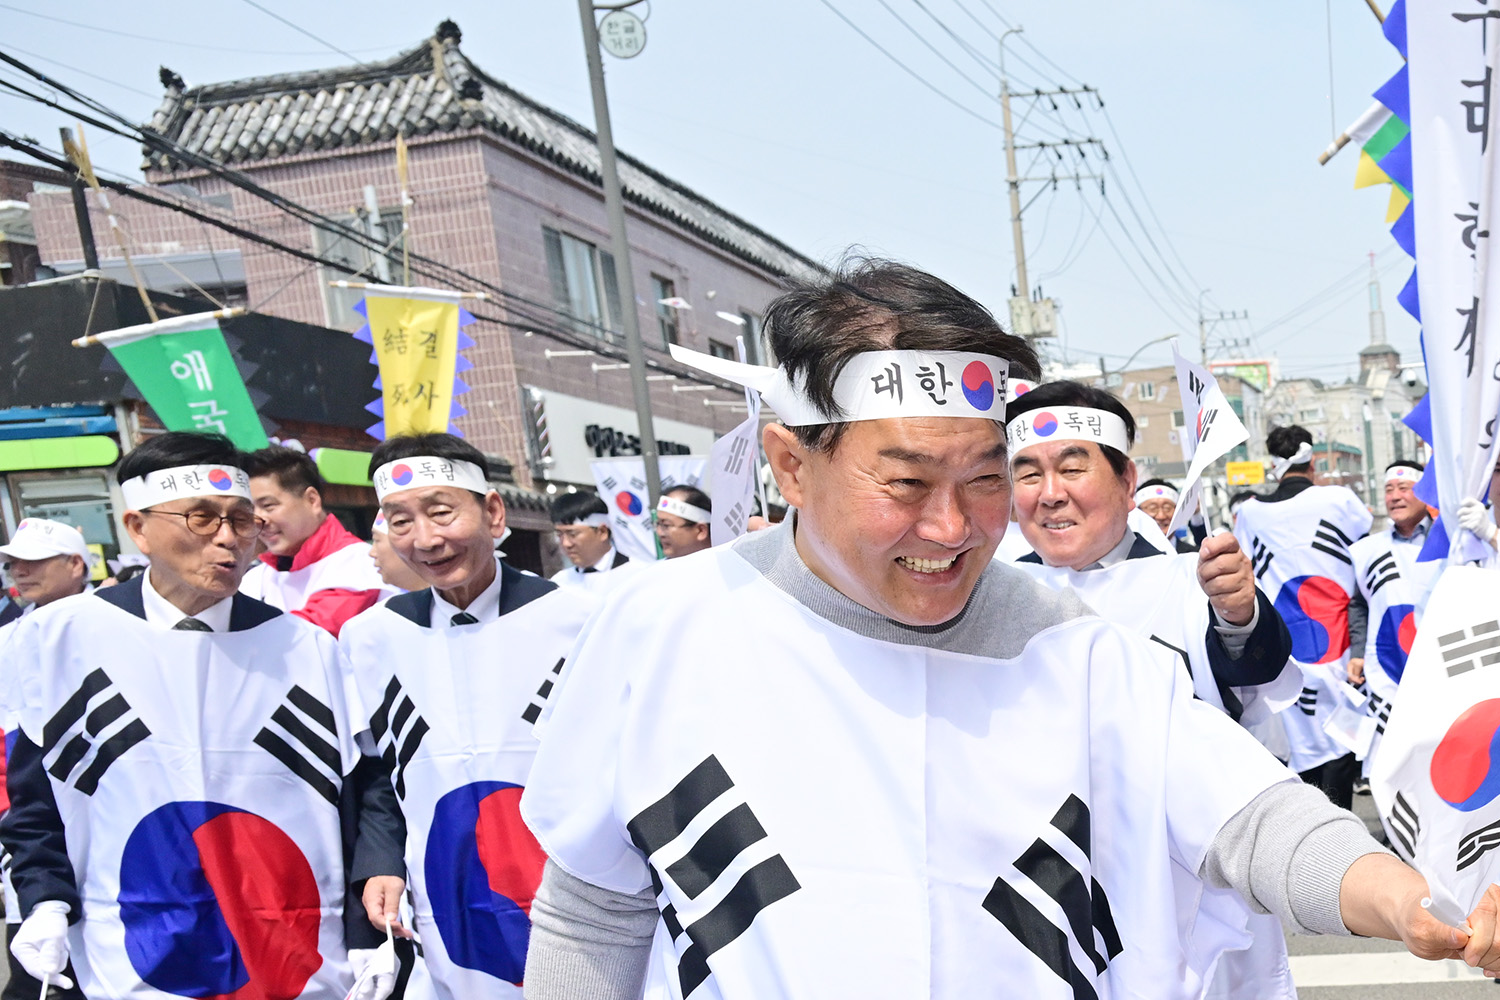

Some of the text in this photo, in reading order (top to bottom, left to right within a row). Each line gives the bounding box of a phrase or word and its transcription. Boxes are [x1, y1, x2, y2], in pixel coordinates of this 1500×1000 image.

[870, 361, 954, 407] 대한
[1064, 411, 1102, 437] 독립
[160, 470, 204, 493] 대한
[418, 462, 454, 482] 독립
